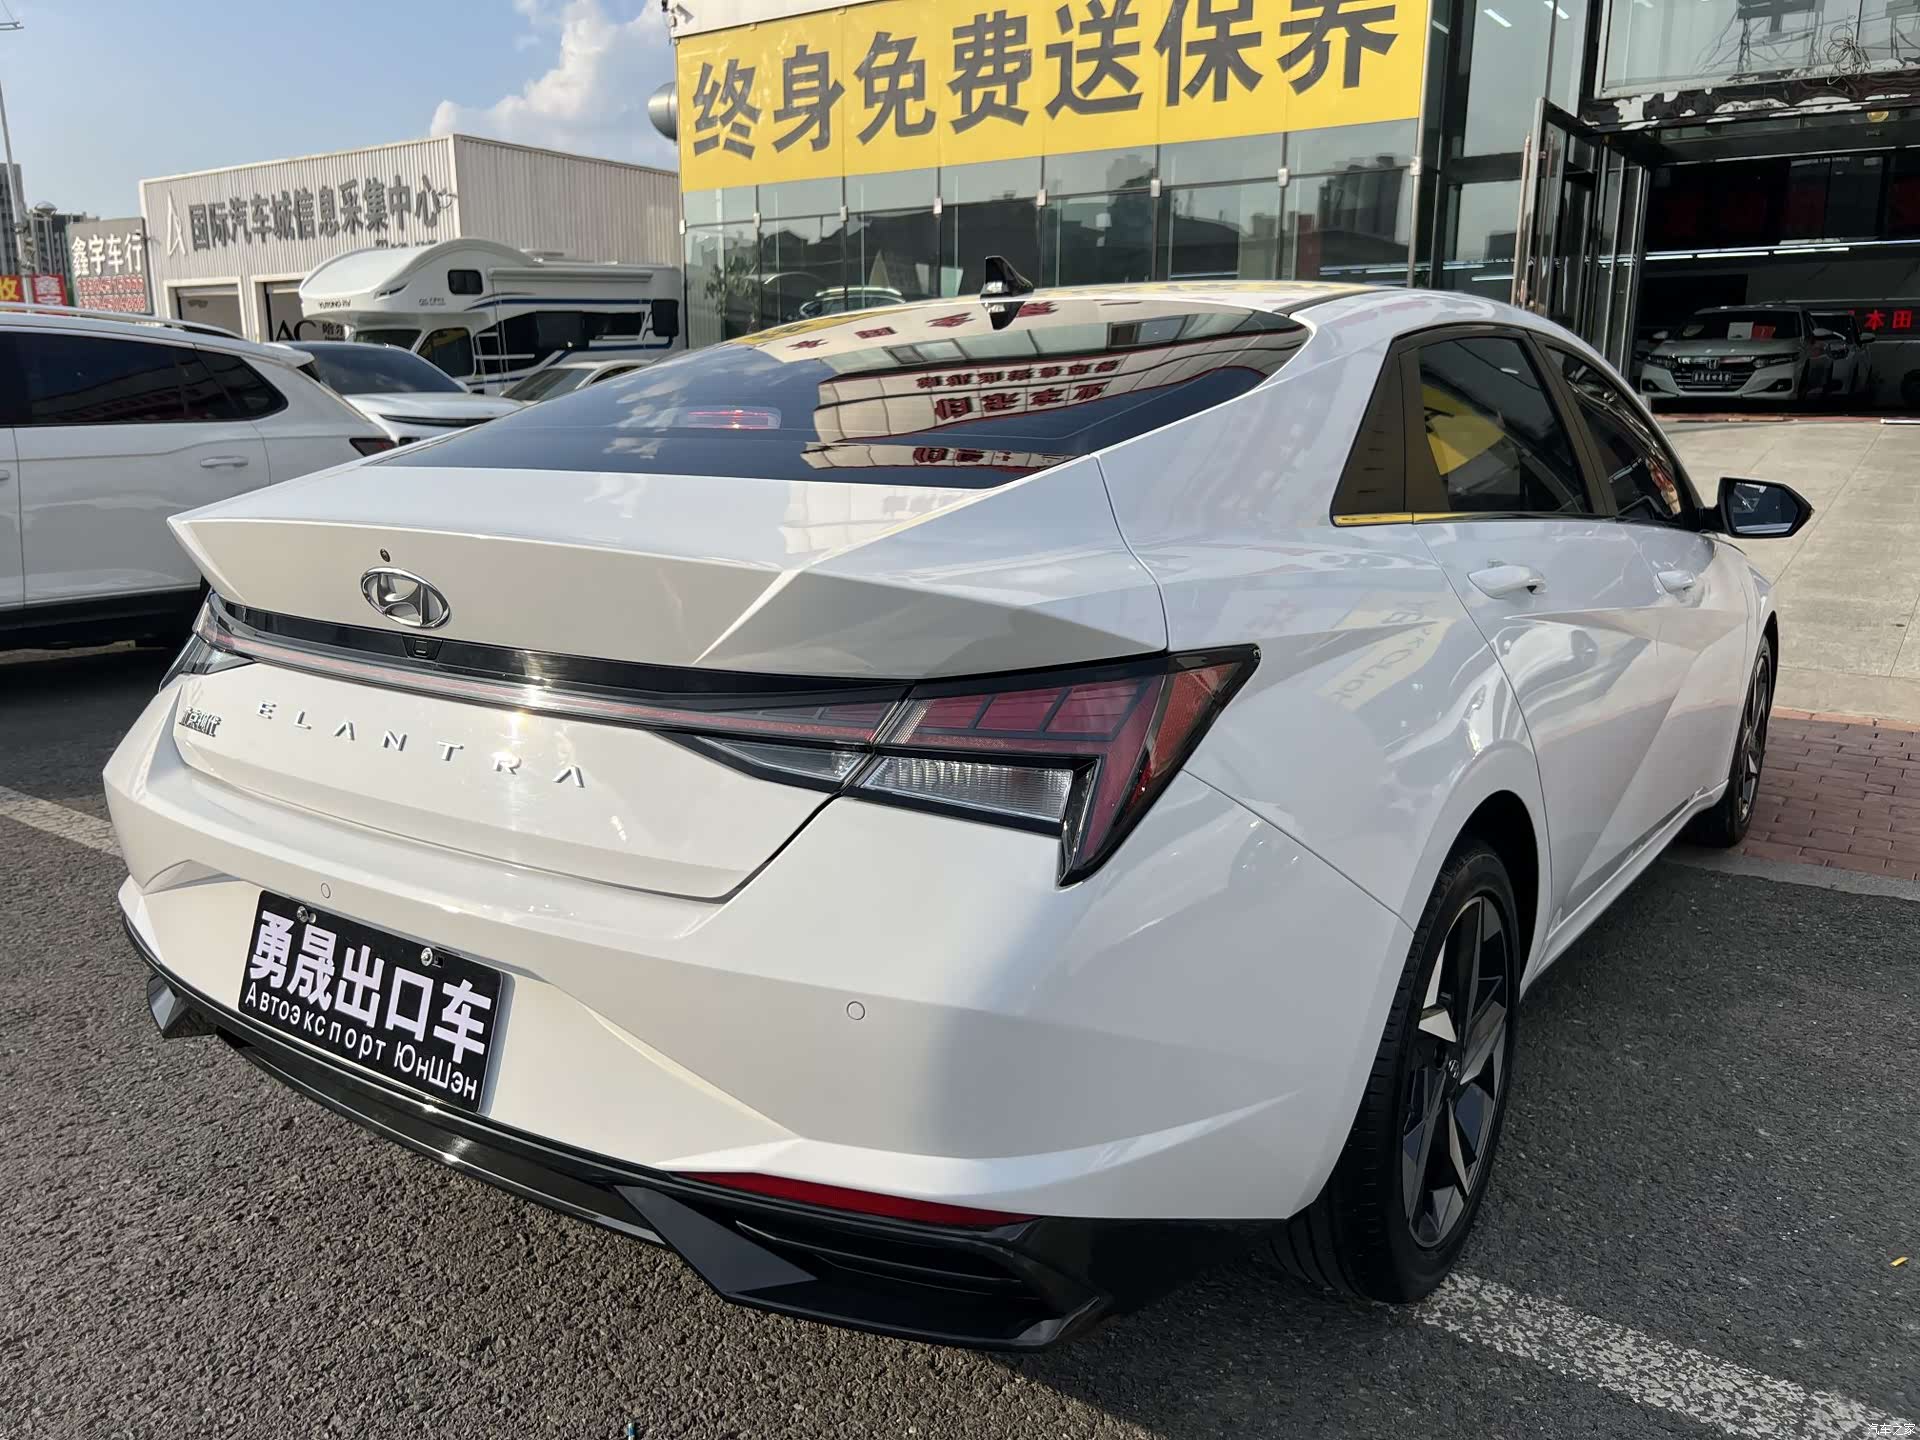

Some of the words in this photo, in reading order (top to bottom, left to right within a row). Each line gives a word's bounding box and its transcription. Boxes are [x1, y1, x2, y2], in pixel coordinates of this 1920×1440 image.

[692, 0, 1398, 160] 终身免费送保养
[188, 175, 439, 251] 国际汽车城信息采集中心
[71, 233, 142, 277] 鑫宇车行
[256, 701, 585, 788] ELANTRA
[250, 910, 492, 1064] 勇晟出口车
[394, 1041, 478, 1100] ЮнШэн
